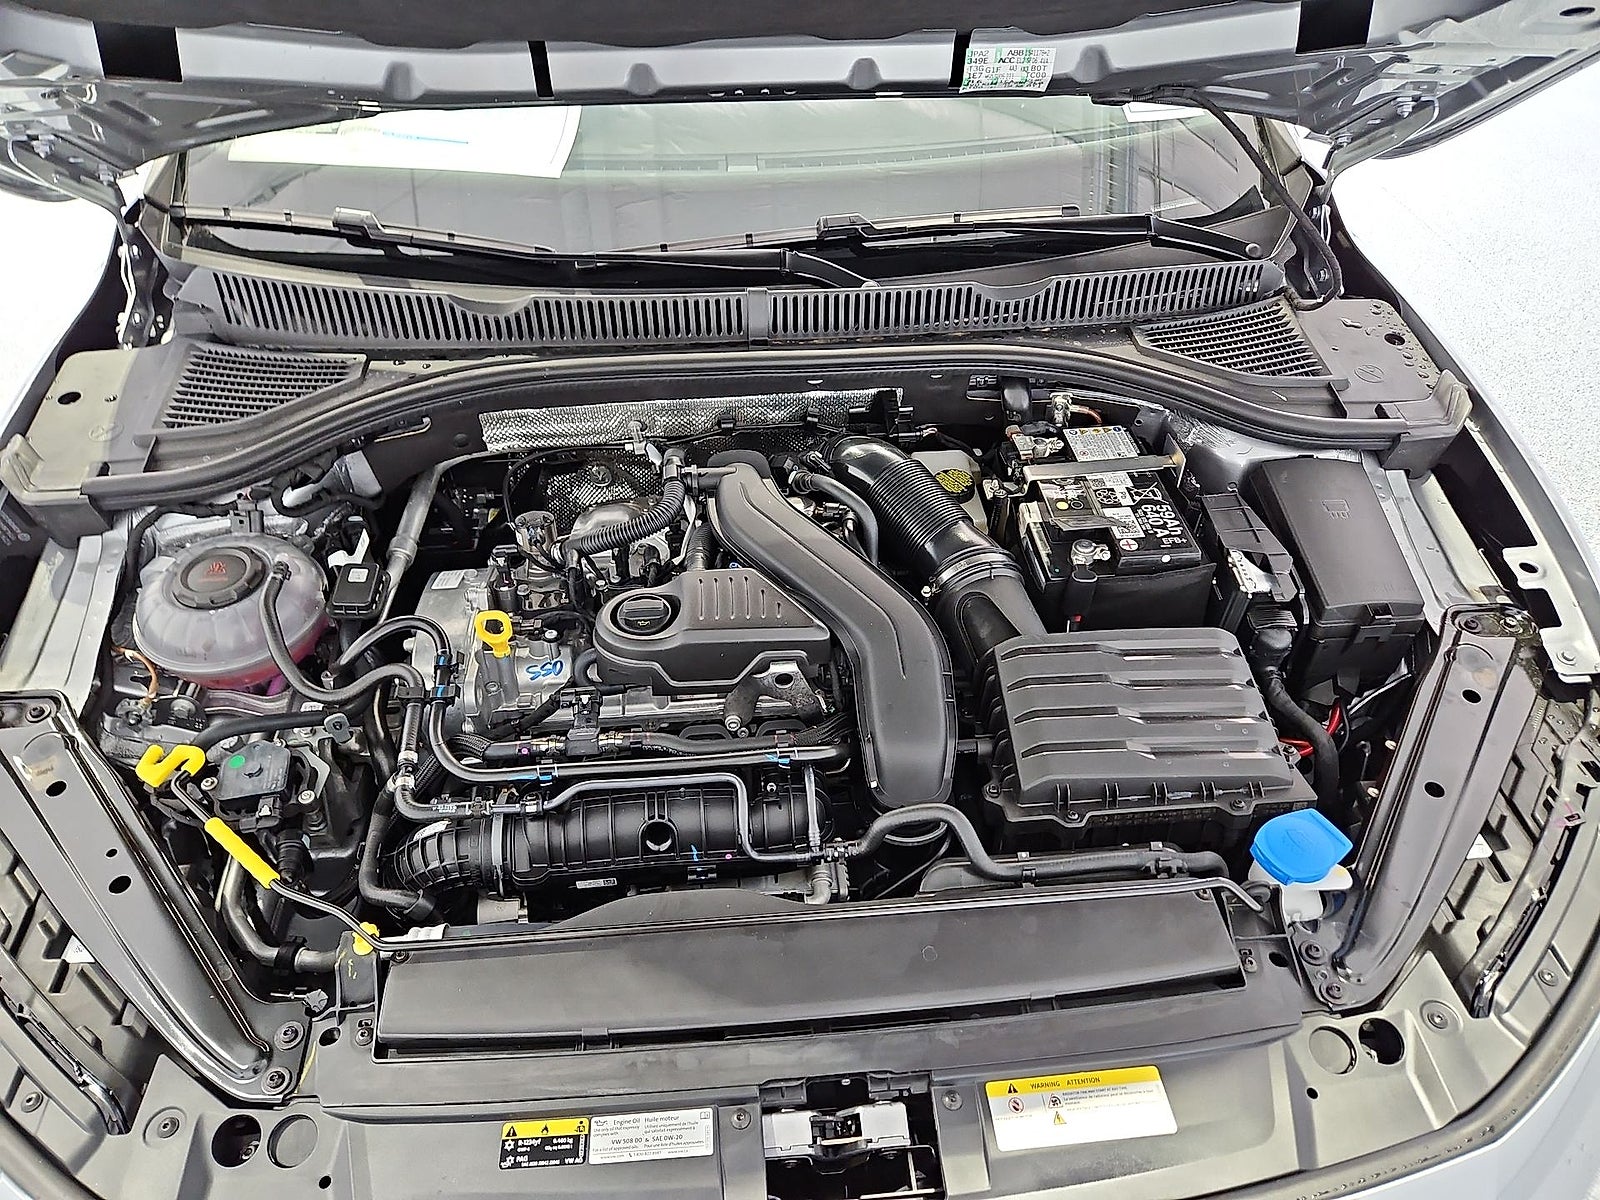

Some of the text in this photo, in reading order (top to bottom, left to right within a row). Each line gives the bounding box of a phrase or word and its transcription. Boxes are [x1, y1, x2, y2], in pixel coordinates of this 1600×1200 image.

[1141, 504, 1164, 526] 640
[1156, 504, 1183, 535] 59Ah
[1152, 527, 1170, 538] A
[1029, 1076, 1101, 1090] WARNING ATTENTION
[613, 1119, 632, 1127] Engine
